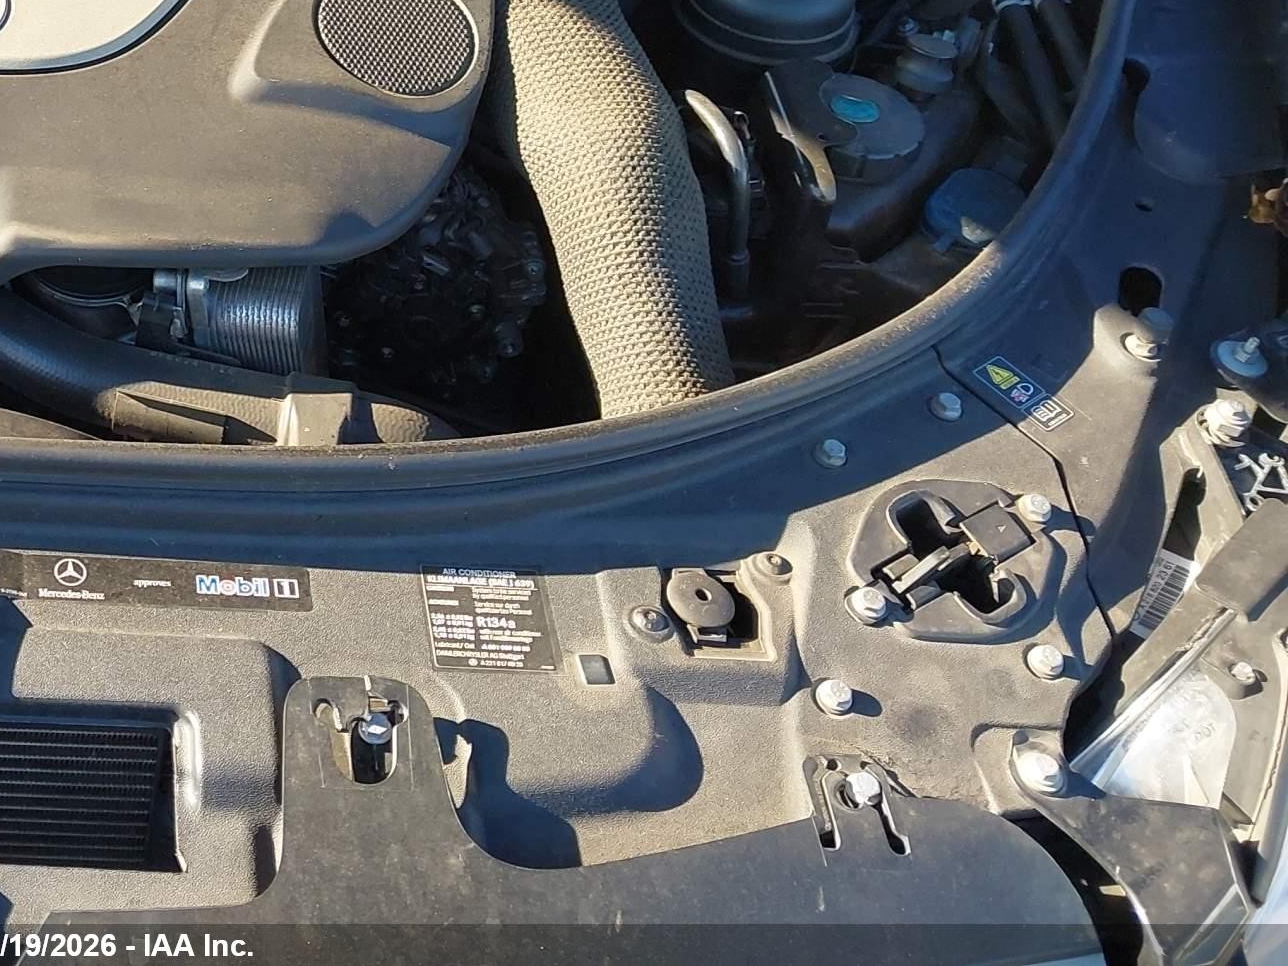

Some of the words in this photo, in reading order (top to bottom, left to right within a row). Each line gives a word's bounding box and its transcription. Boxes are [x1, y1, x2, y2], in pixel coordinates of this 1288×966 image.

[458, 569, 516, 578] CONDITIONER
[133, 579, 172, 588] approves
[195, 574, 270, 597] Mobil
[38, 588, 106, 600] Mercedes-Benz
[476, 617, 516, 629] R134a
